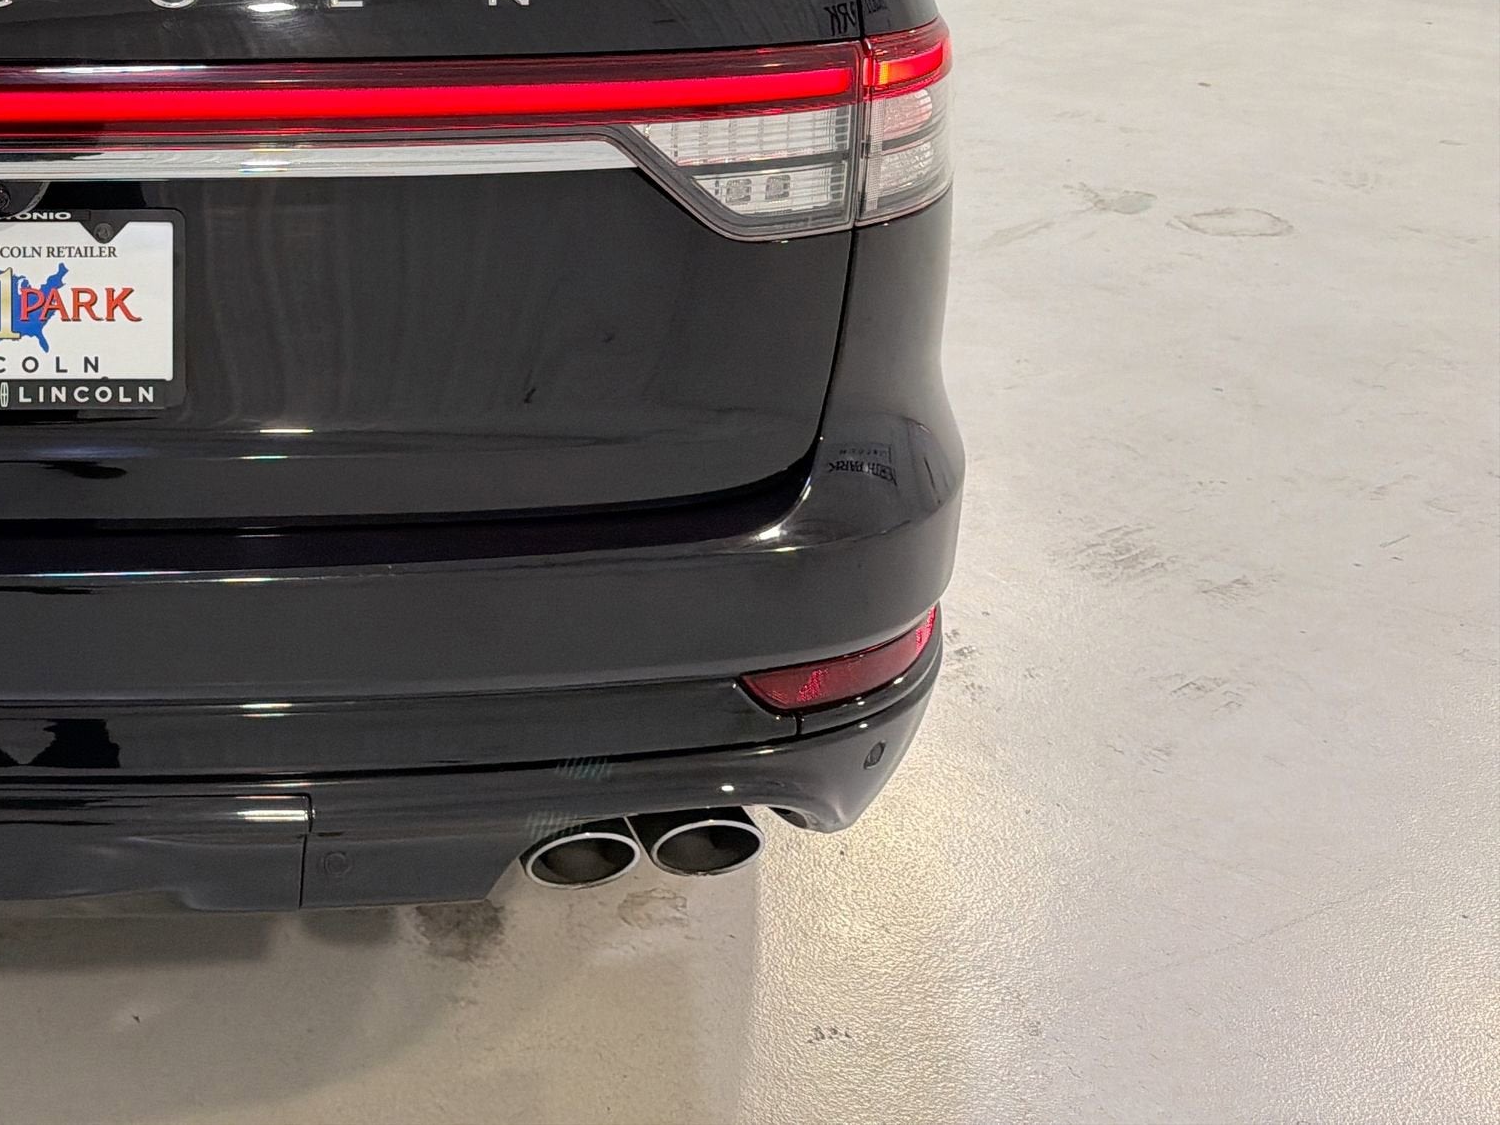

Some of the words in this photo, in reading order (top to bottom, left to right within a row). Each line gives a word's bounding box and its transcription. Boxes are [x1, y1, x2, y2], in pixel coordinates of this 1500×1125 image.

[46, 246, 118, 258] RETAILER
[19, 287, 143, 323] PARK
[18, 386, 155, 404] LINCOLN
